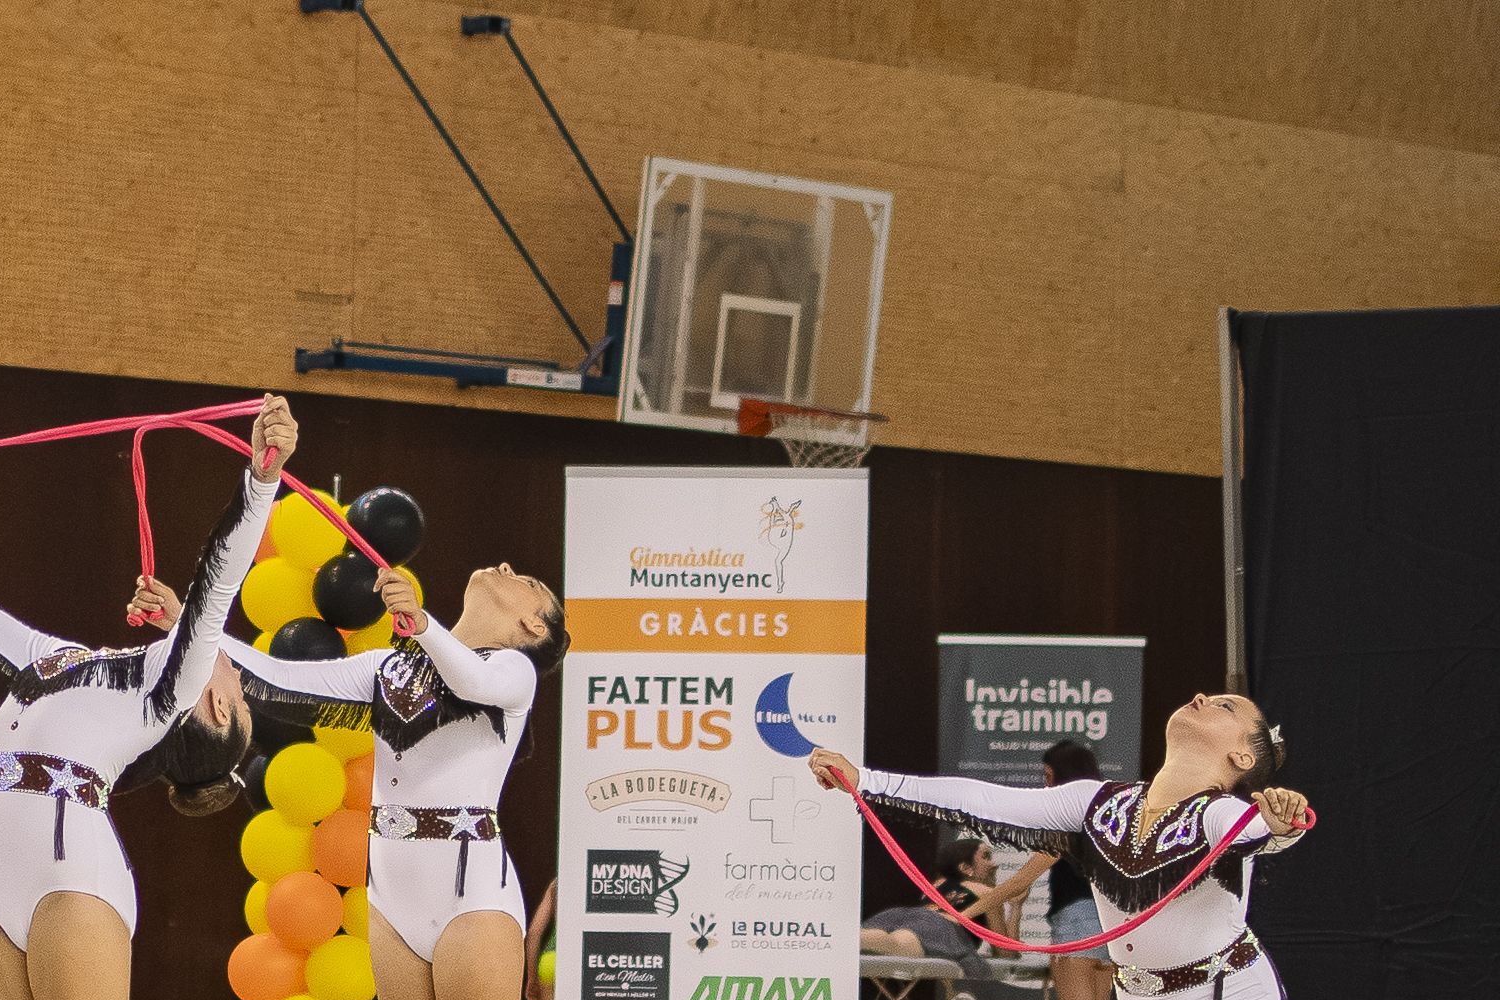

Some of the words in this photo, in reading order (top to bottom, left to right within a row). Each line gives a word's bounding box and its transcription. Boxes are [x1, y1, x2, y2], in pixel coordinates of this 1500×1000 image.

[629, 546, 745, 569] Gimnàstica
[630, 568, 773, 593] Muntanyenc
[639, 607, 789, 637] GRÀCIES
[587, 676, 733, 705] FAITEM
[586, 709, 733, 751] PLUS
[971, 704, 1108, 740] training
[600, 782, 619, 801] LA
[625, 776, 718, 802] BODEGUETA
[592, 864, 617, 879] MY
[619, 864, 652, 879] DNA
[724, 852, 835, 882] farmàcia
[591, 879, 653, 895] DESIGN
[753, 922, 832, 937] RURAL
[731, 939, 748, 949] DE
[752, 940, 832, 951] COLLSEROLA
[588, 954, 606, 968] EL
[607, 954, 663, 969] CELLER
